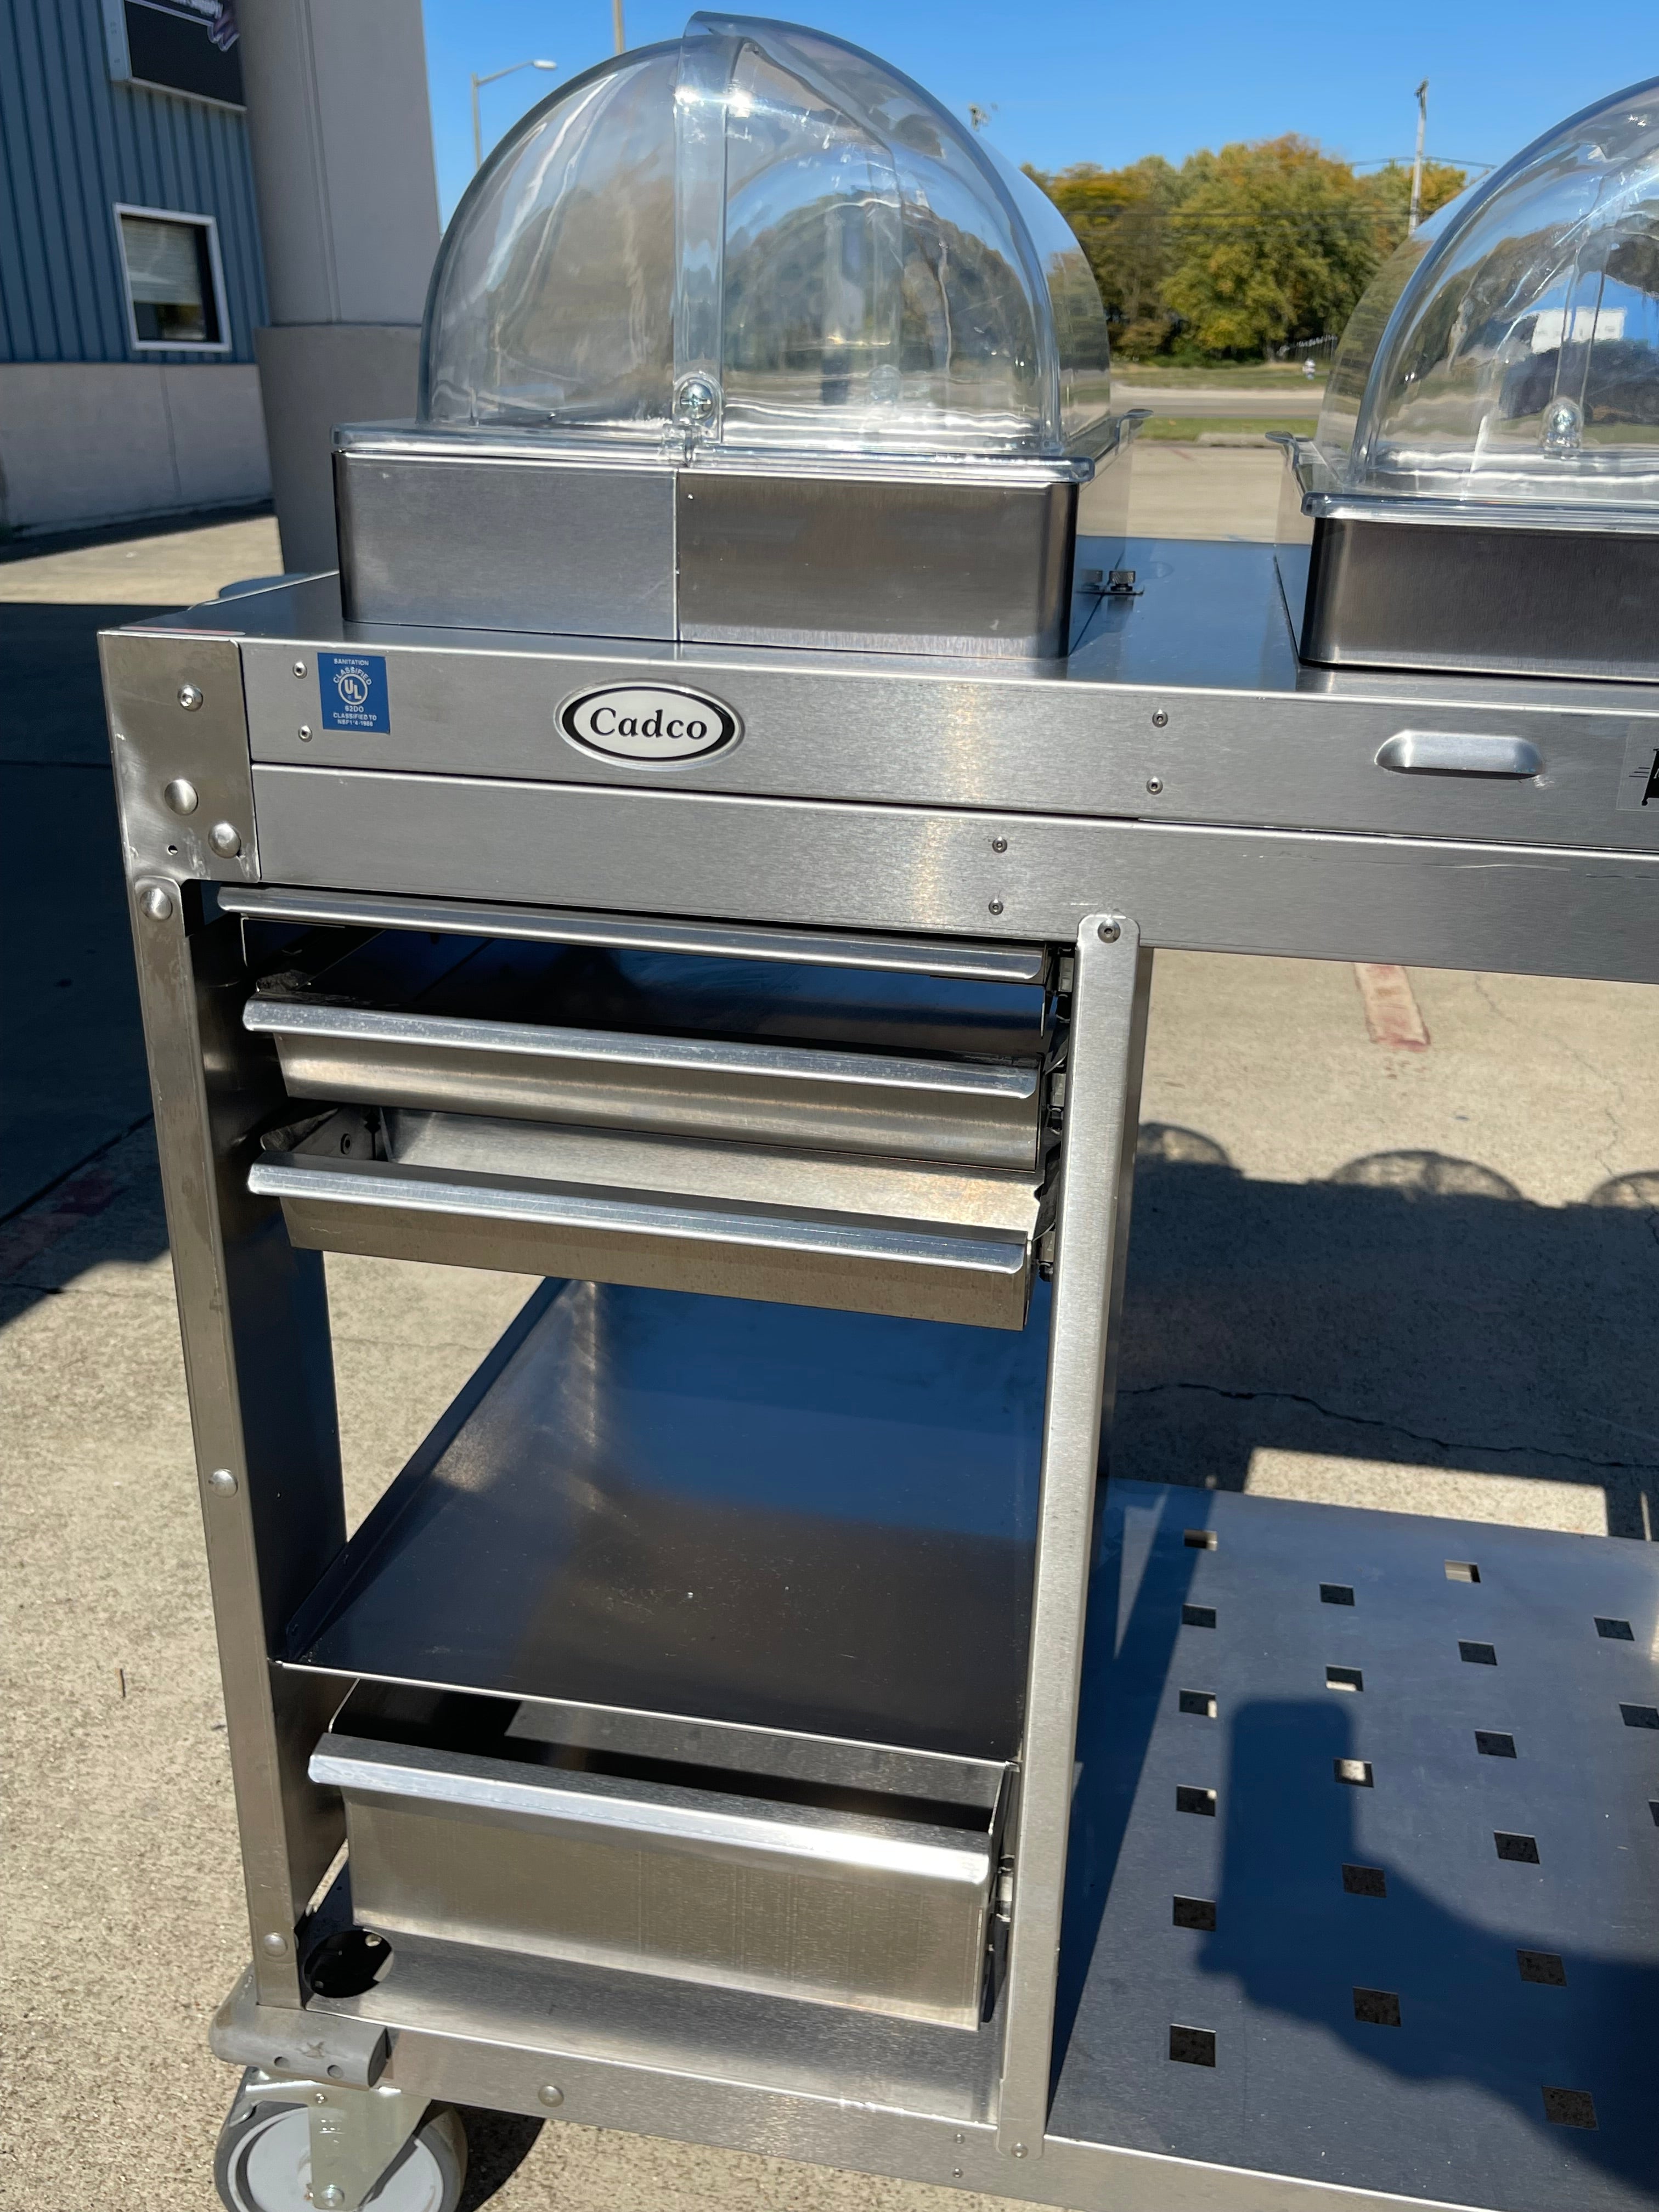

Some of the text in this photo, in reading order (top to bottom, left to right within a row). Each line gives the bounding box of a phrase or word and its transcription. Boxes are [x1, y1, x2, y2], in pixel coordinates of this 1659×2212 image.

[333, 667, 372, 686] CLASSIFIED
[344, 679, 362, 699] UL
[333, 712, 368, 720] CLASSIFIED
[590, 707, 707, 740] Cadco
